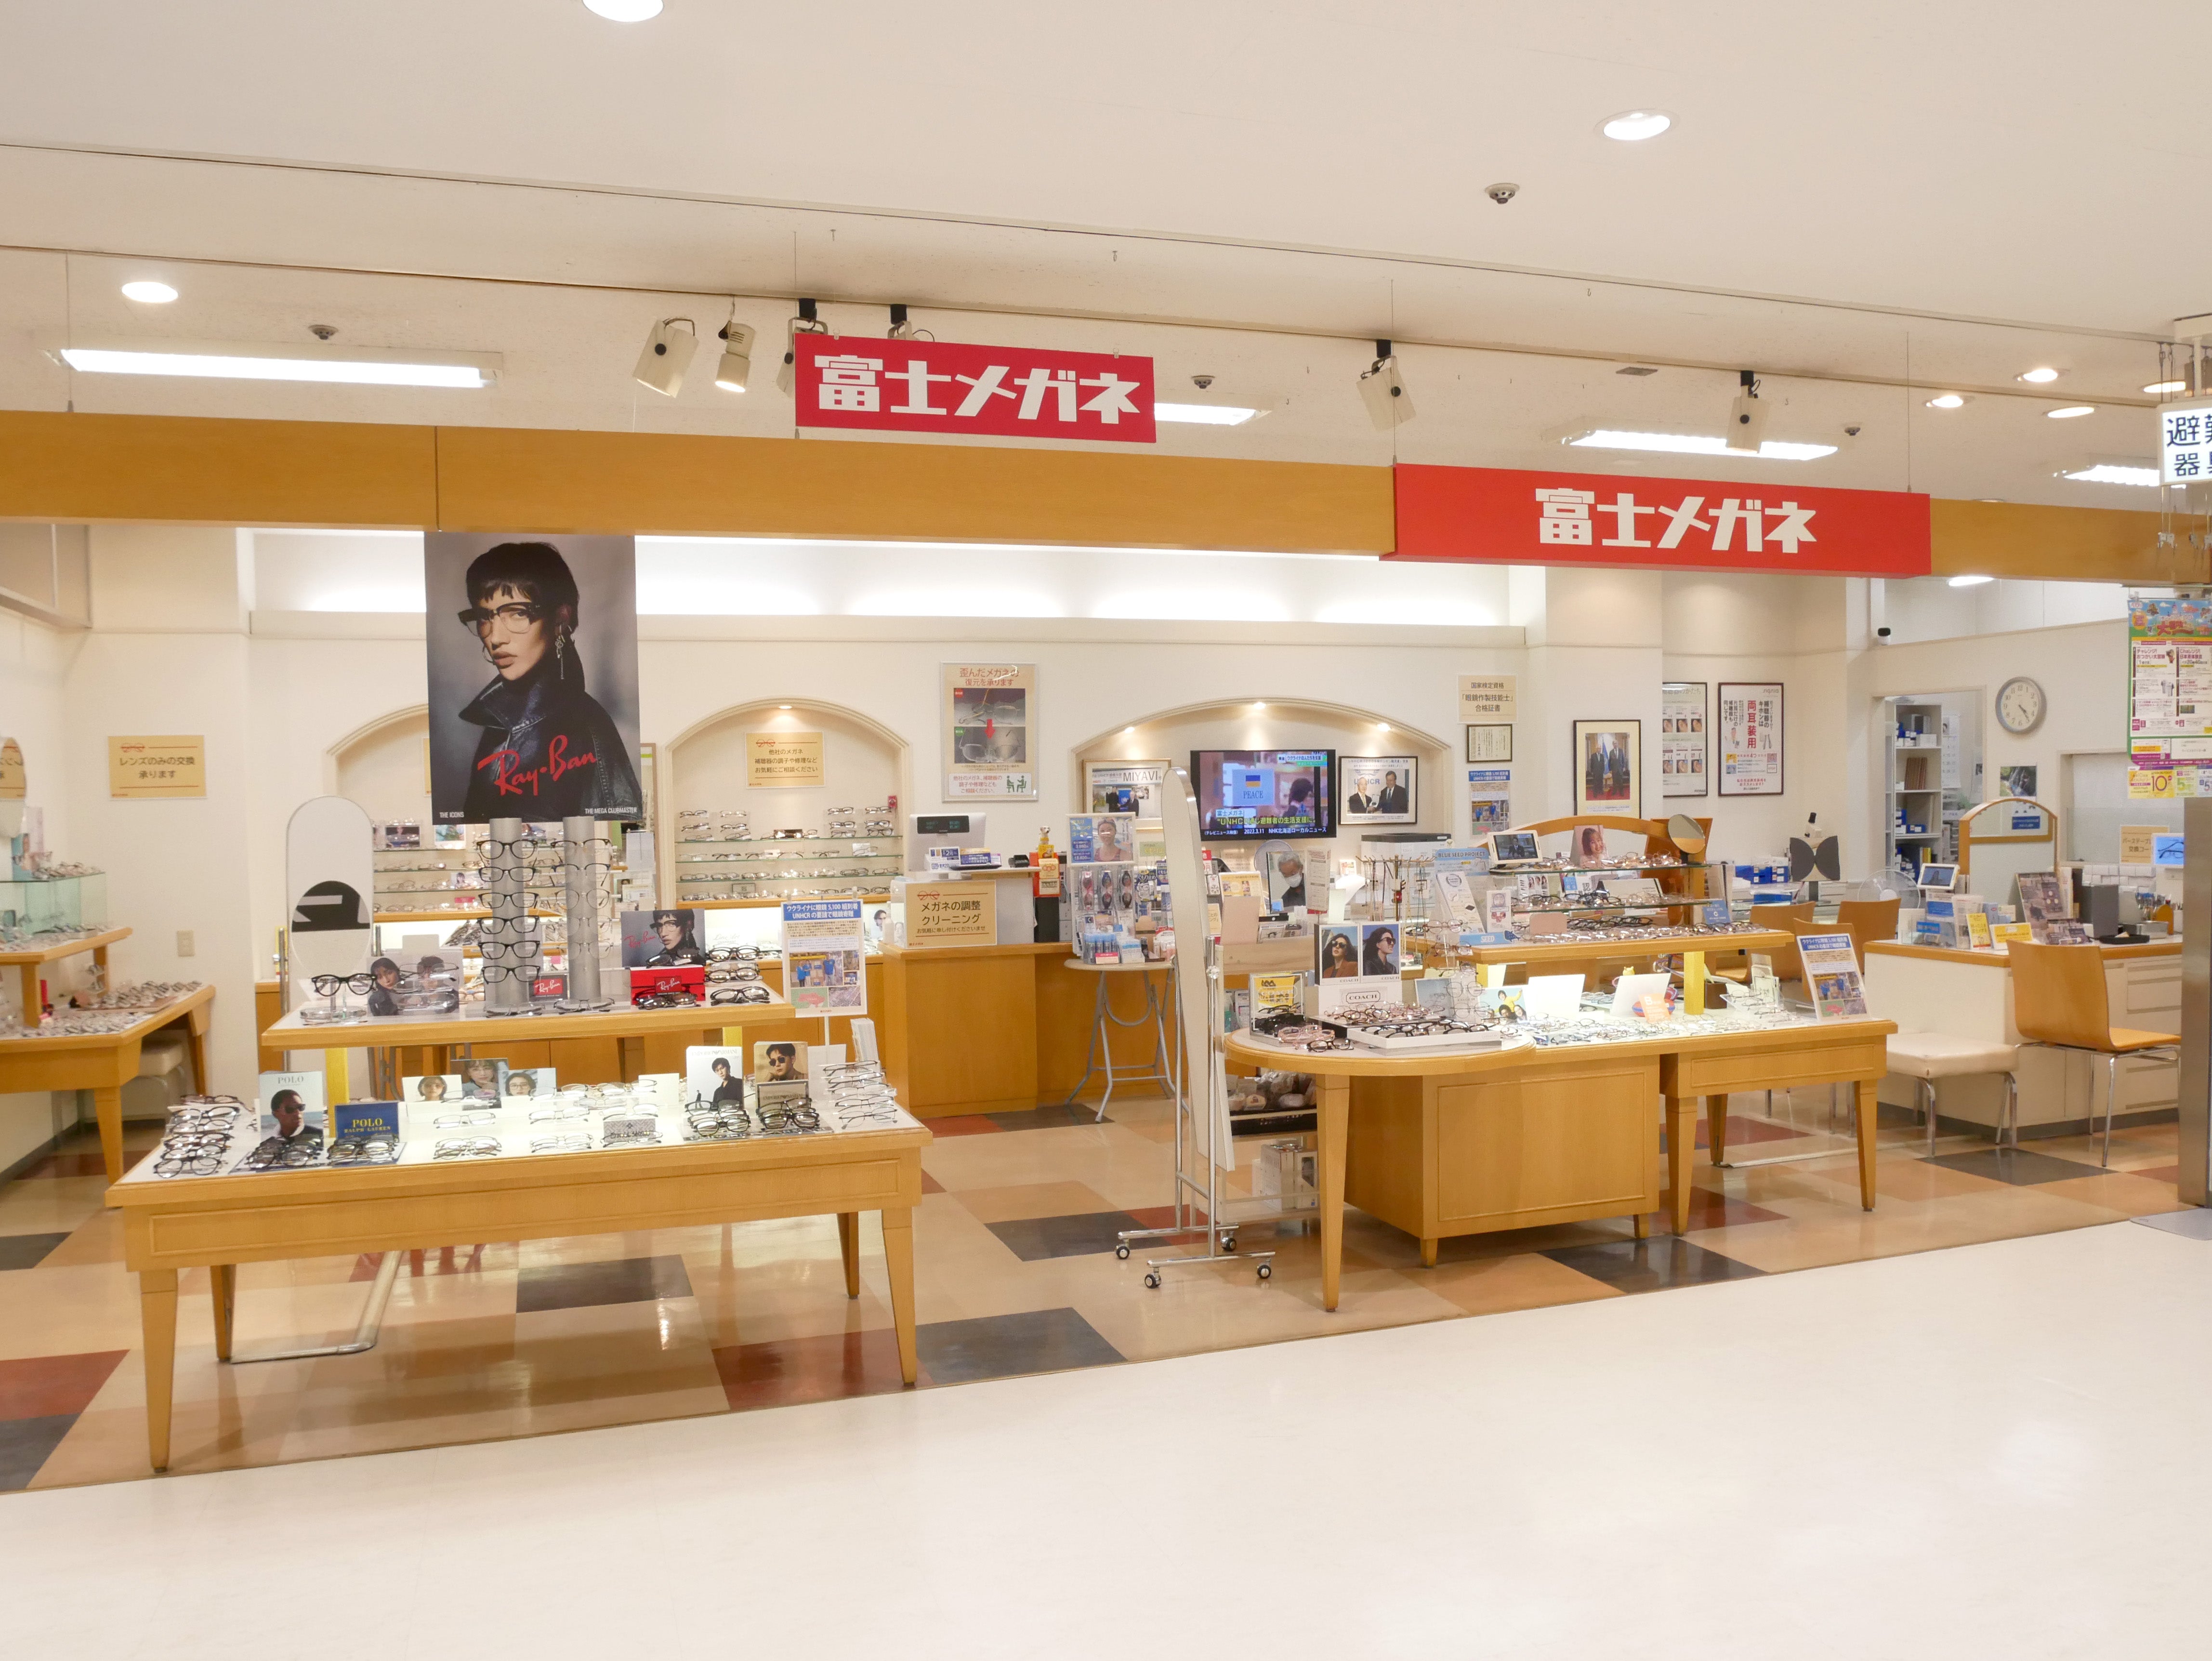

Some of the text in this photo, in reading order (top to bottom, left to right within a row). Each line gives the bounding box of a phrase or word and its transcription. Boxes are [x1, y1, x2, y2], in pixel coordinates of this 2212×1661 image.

[815, 355, 1141, 424] 富士メガネ
[2174, 451, 2212, 476] 器
[1535, 488, 1817, 554] 富士メガネ
[965, 678, 1014, 686] 復元を承ります
[1747, 700, 1756, 749] 両耳装用
[120, 756, 195, 765] レンズのみの交換
[477, 735, 597, 795] Ray-Ban
[139, 771, 176, 779] 承ります
[1123, 771, 1158, 782] MIYAVI
[1243, 790, 1264, 799] PEACE
[921, 900, 981, 912] メガネの調整
[922, 913, 981, 925] クリーニング
[917, 926, 986, 934] お気軽に申し付けくださいませ
[535, 979, 561, 994] Ray-Ban
[657, 977, 680, 991] Ray-Ban
[278, 1076, 304, 1084] POLO
[352, 1118, 383, 1128] POLO
